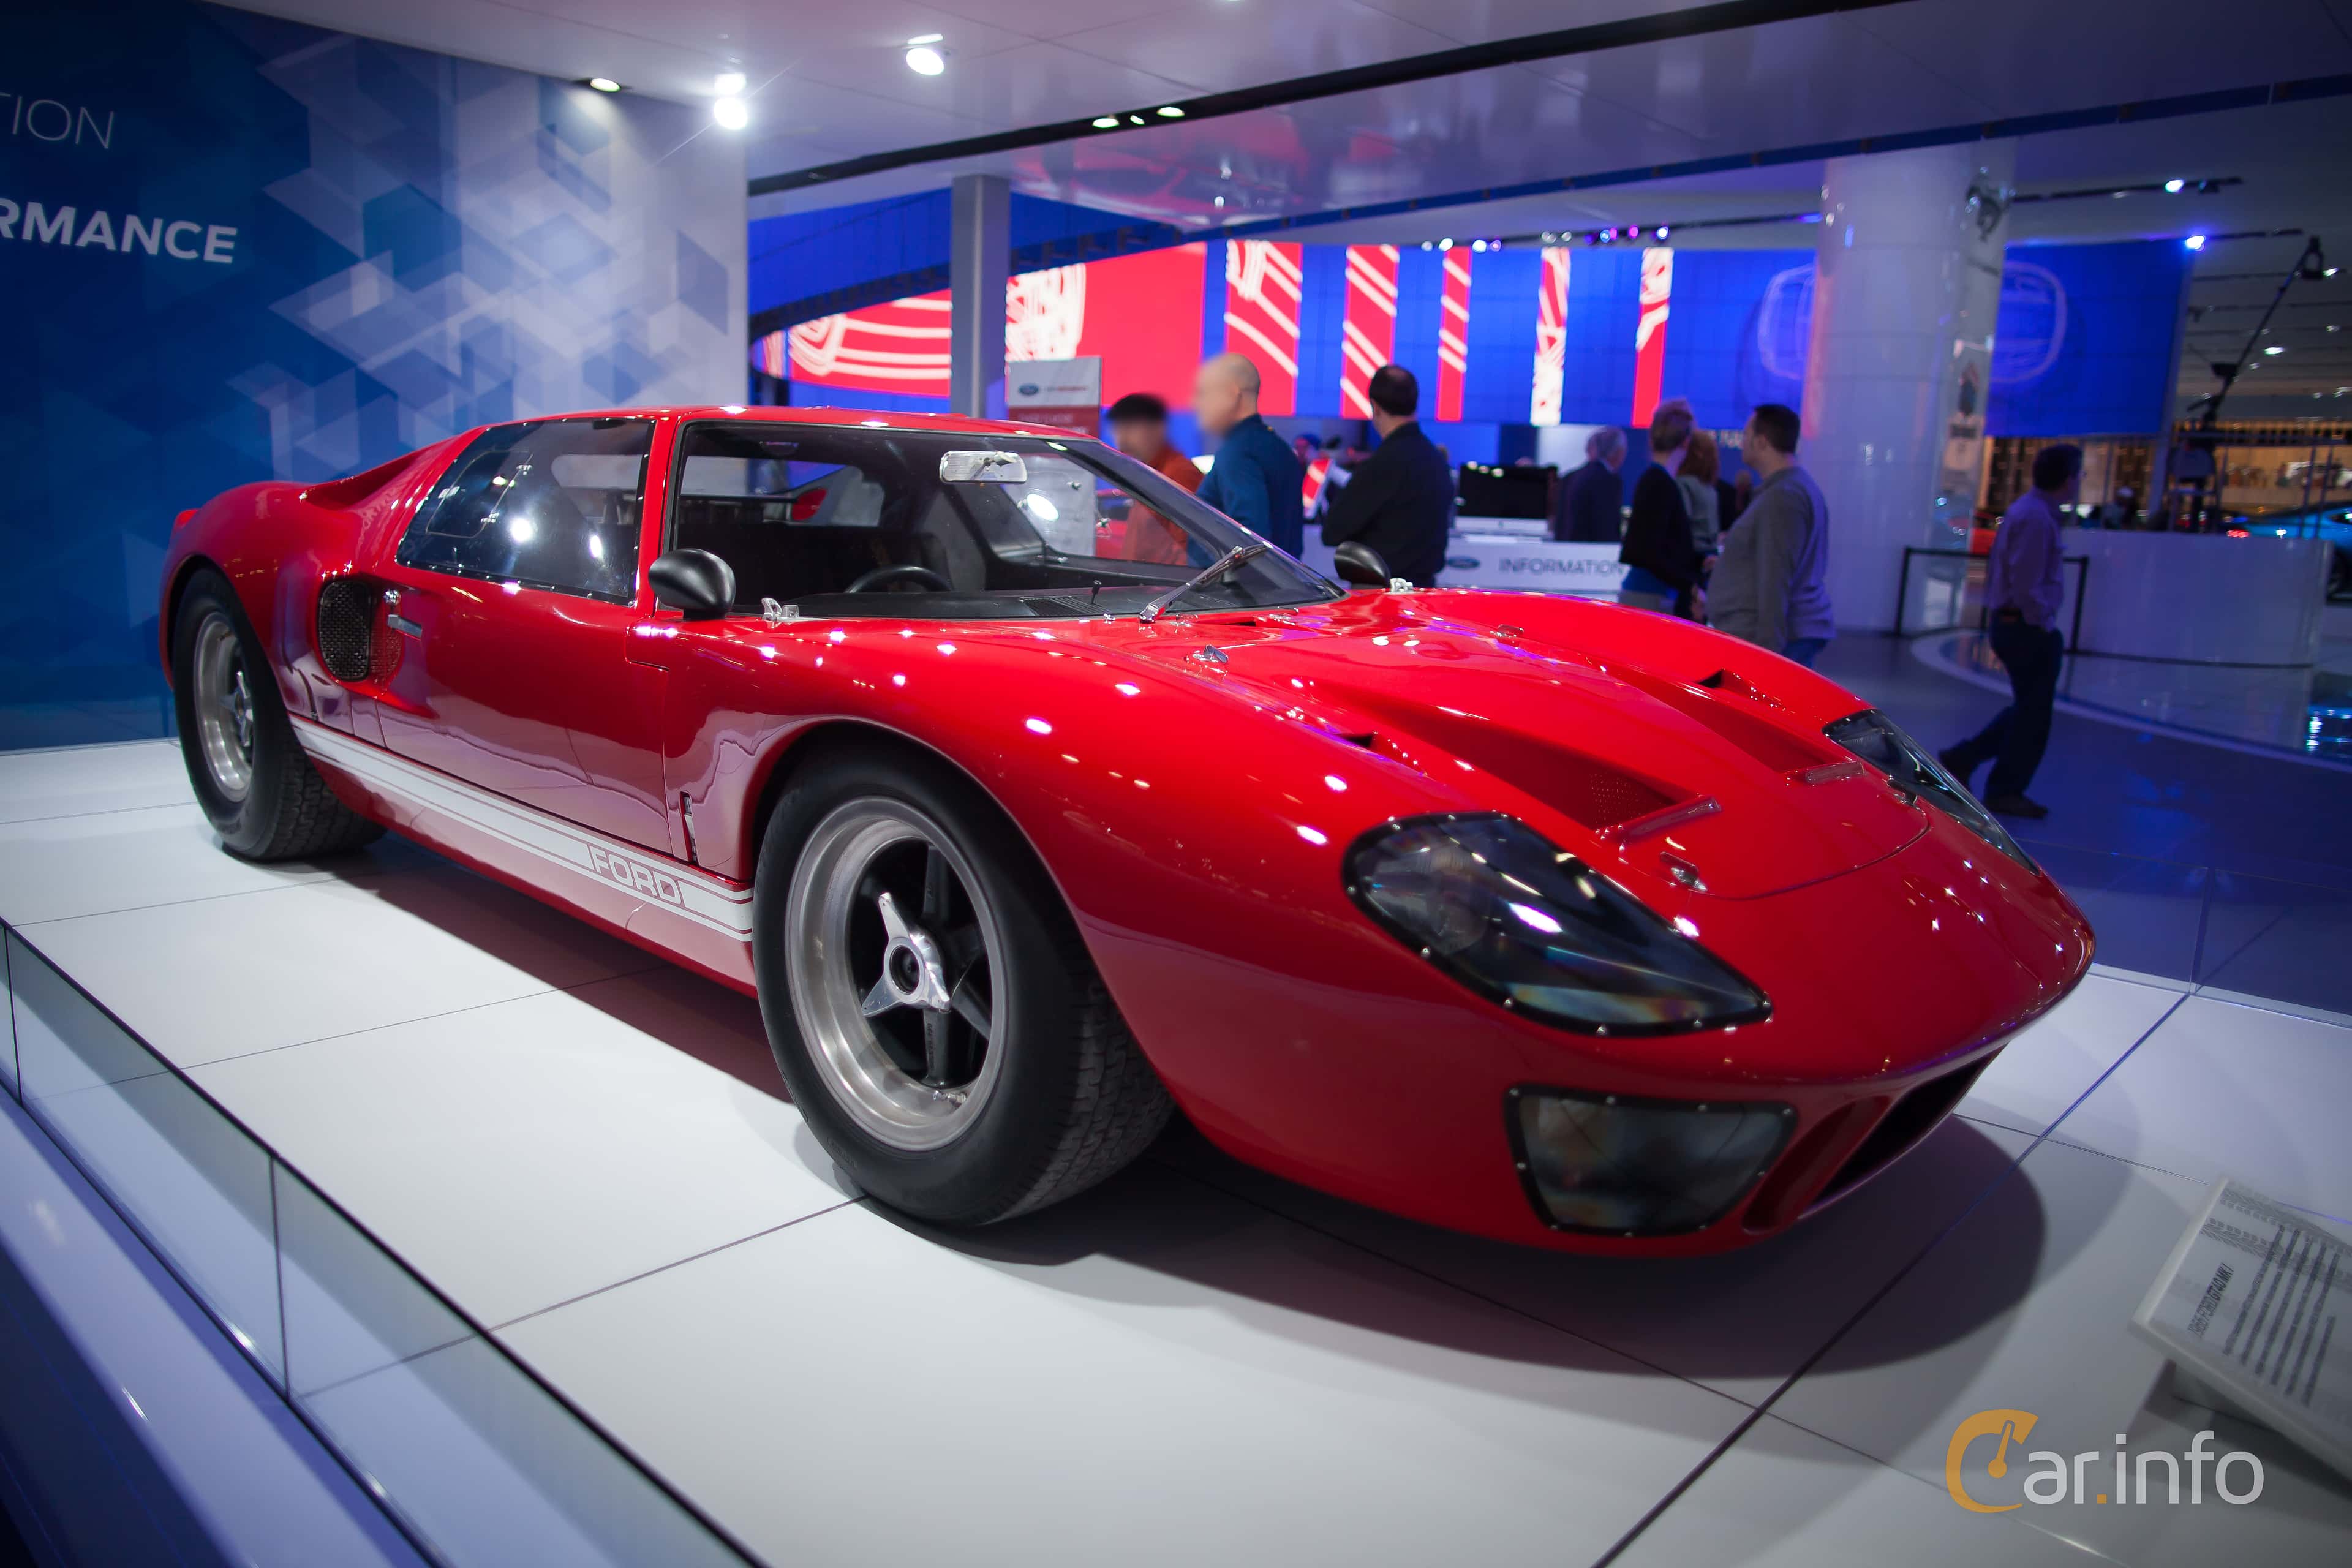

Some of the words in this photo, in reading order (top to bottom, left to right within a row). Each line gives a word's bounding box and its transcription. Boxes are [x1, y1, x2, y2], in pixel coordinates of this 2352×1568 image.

[0, 92, 114, 149] ION
[1499, 557, 1623, 576] INFORMATION
[589, 845, 682, 905] FORD
[2205, 1277, 2227, 1301] GT40
